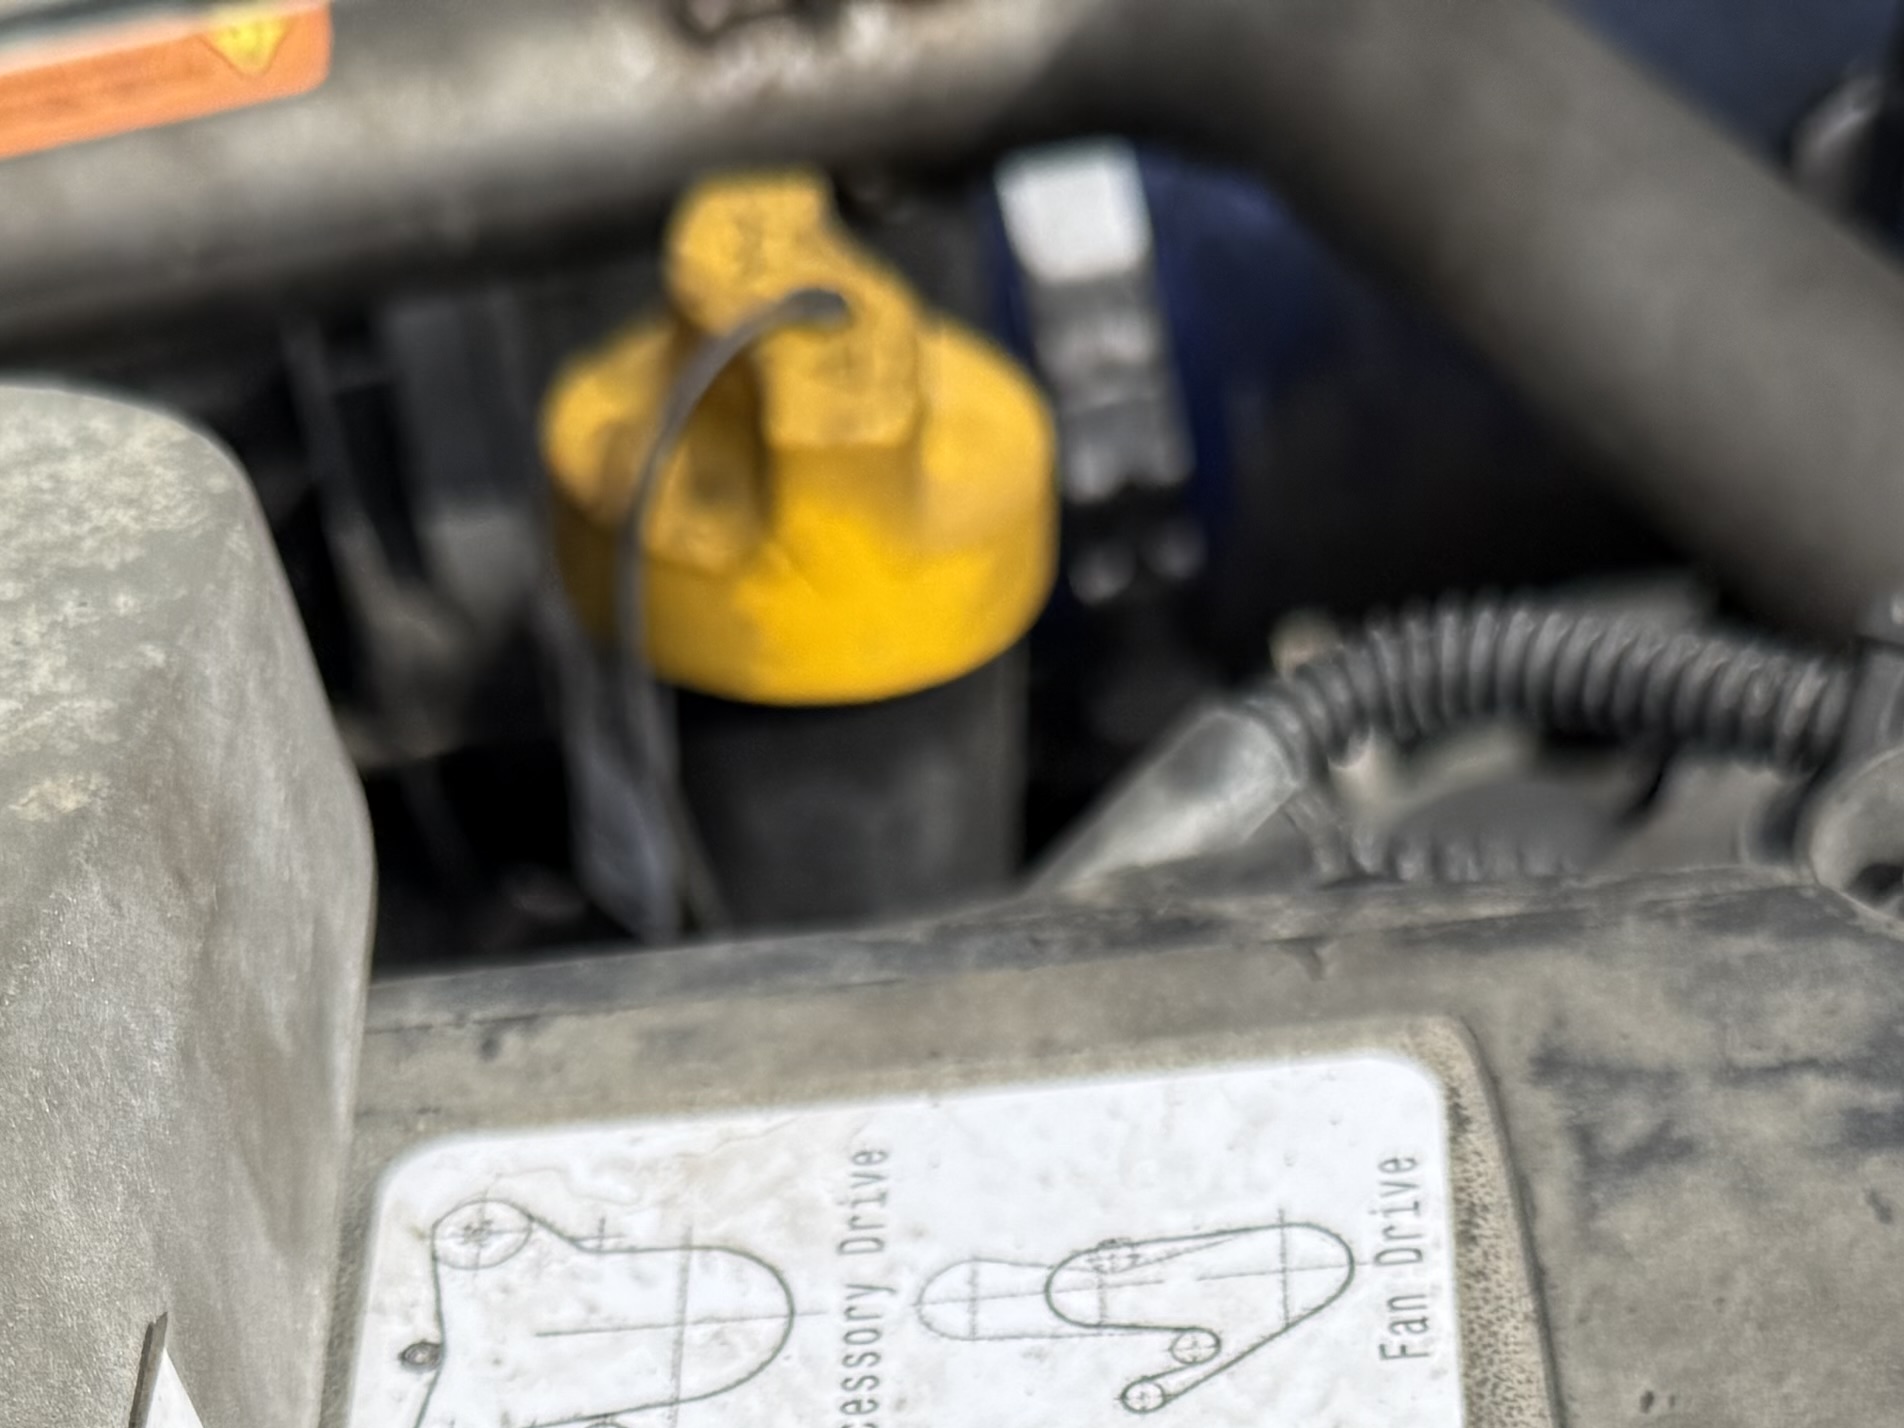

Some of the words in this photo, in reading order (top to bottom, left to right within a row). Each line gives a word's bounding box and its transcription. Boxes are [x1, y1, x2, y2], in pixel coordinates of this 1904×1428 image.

[836, 1148, 888, 1255] Drive
[1369, 1156, 1424, 1267] Drive
[1378, 1294, 1432, 1360] Fan
